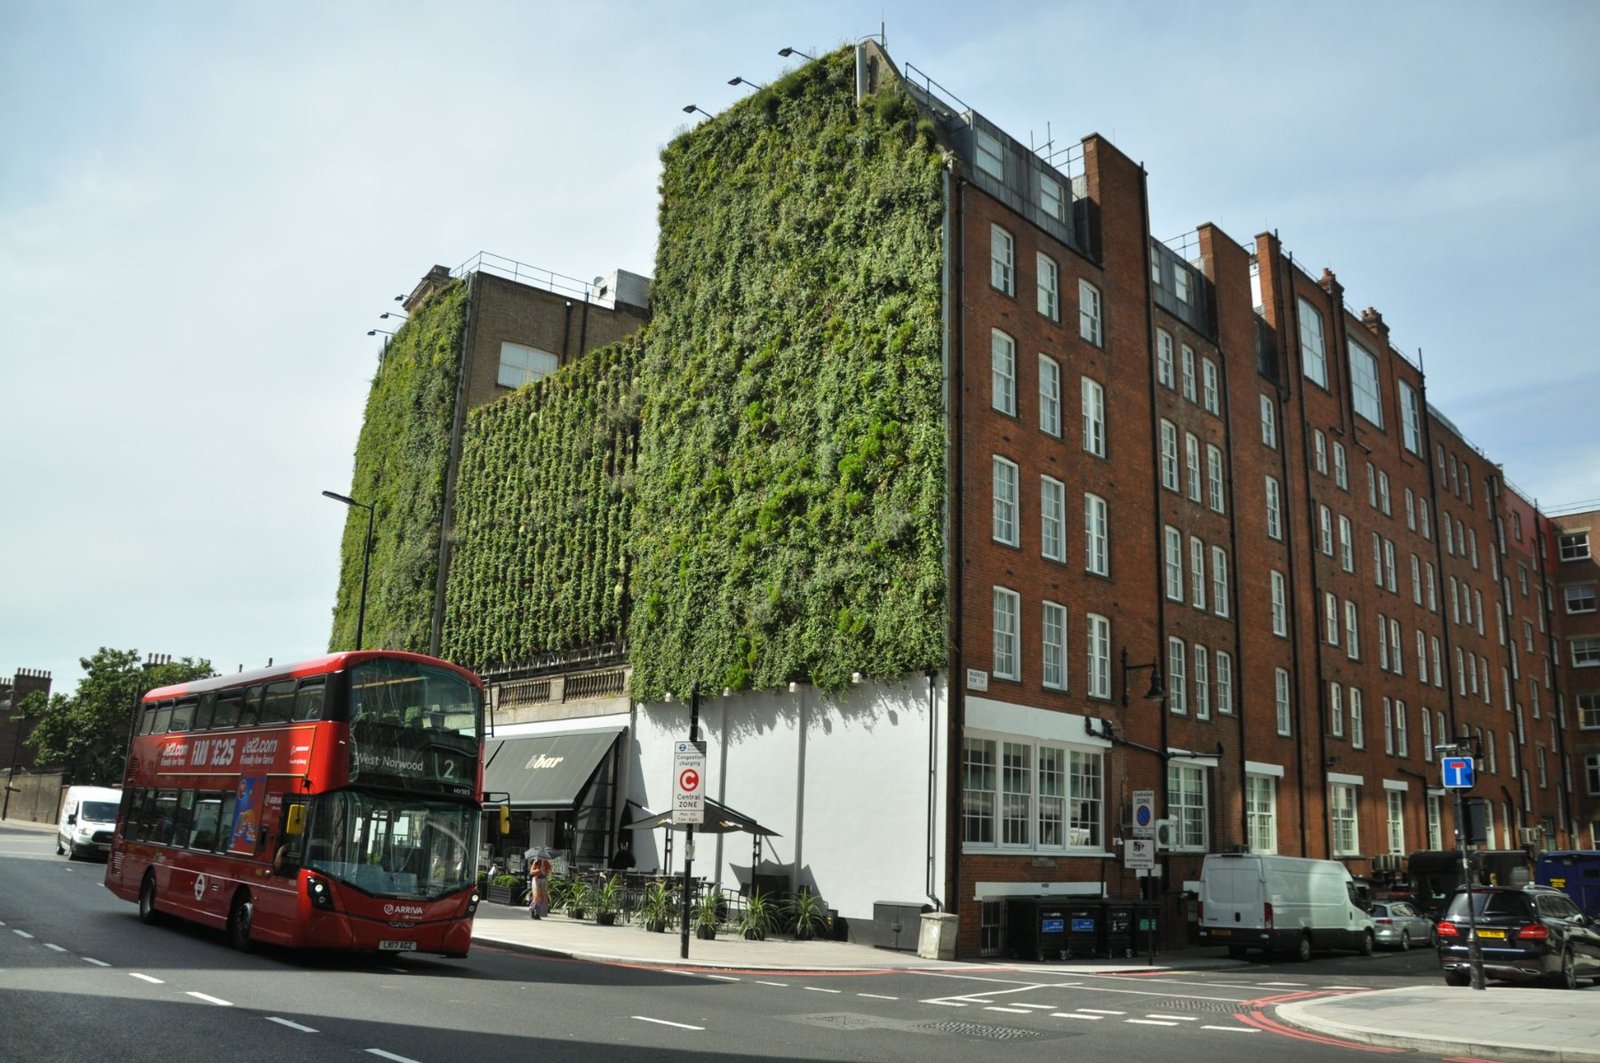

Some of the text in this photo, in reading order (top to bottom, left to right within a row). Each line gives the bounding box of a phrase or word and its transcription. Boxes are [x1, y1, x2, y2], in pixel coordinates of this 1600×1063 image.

[242, 737, 278, 753] Jet2.com
[358, 752, 455, 779] West Norwood 2
[394, 905, 423, 915] ARRIVA
